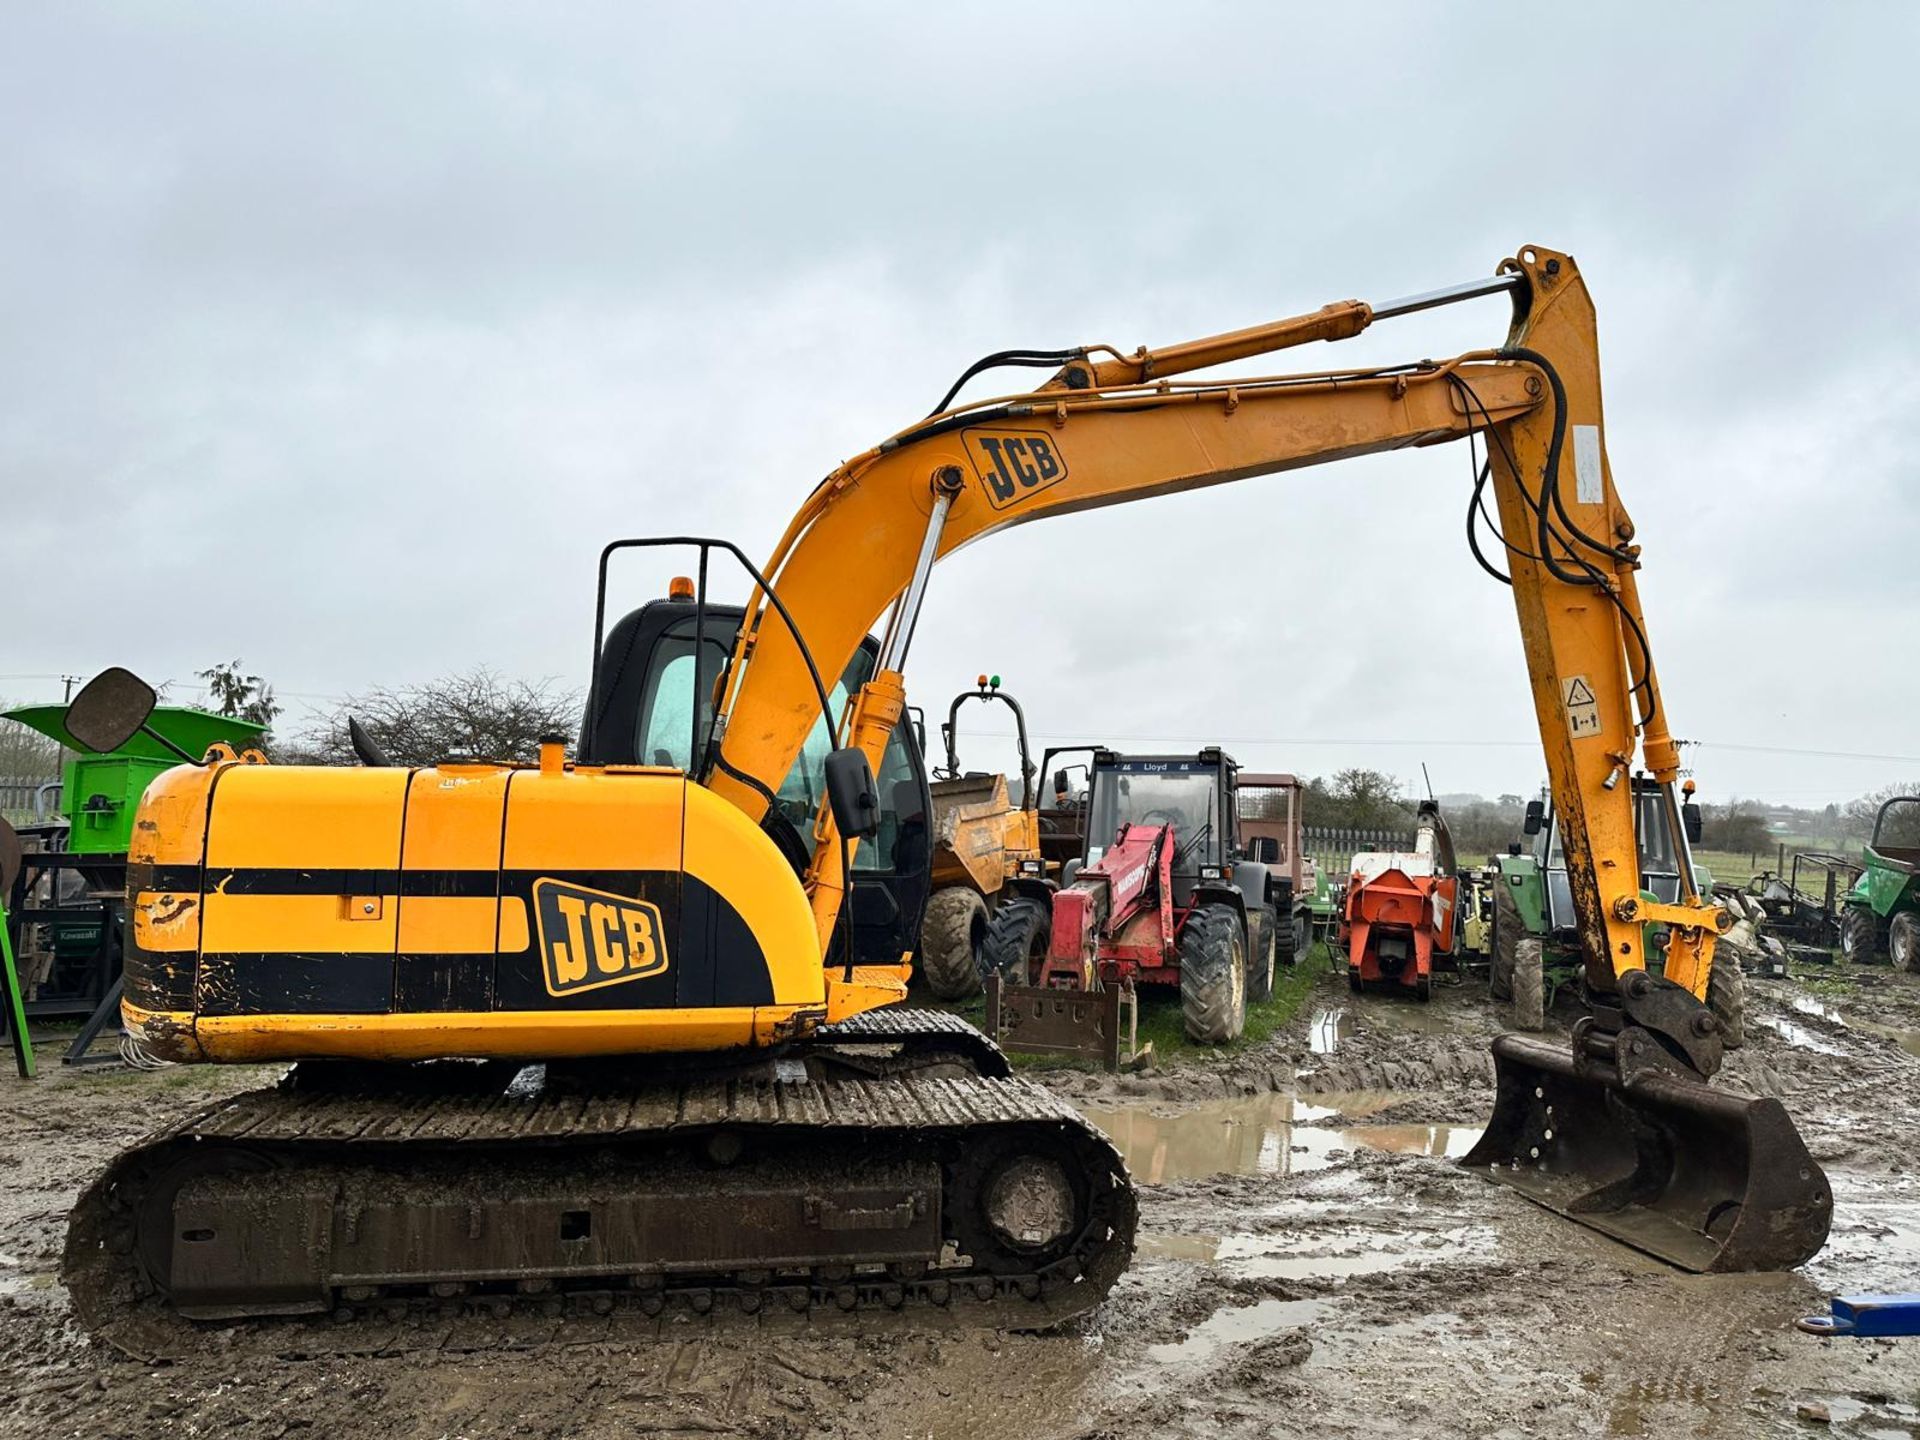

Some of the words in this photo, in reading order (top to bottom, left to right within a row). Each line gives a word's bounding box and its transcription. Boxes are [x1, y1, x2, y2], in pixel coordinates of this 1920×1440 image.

[979, 438, 1059, 502] JCB
[1143, 763, 1168, 772] Lloyd
[60, 930, 97, 941] Kawasaki
[552, 894, 657, 985] JCB
